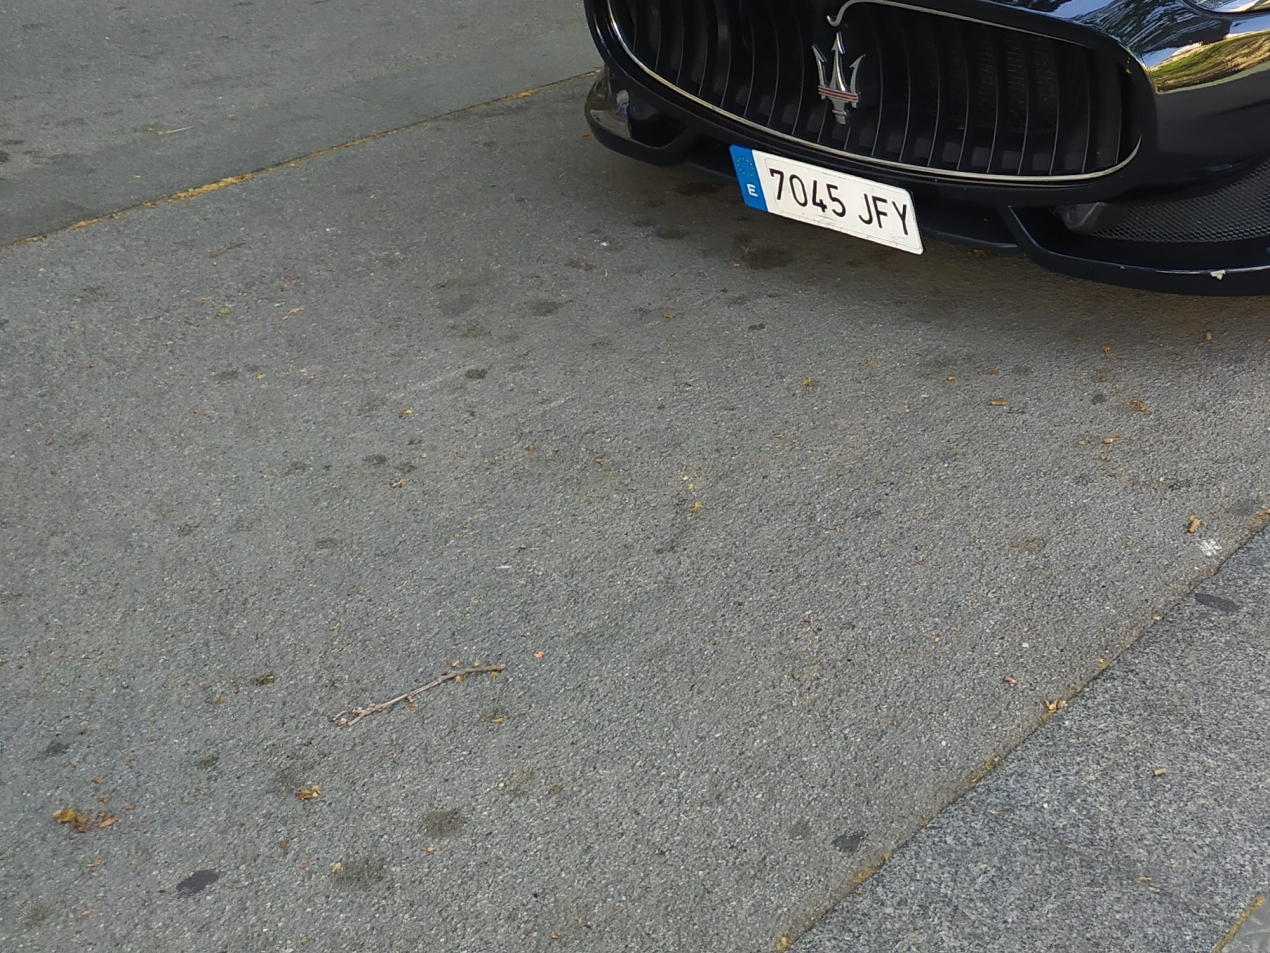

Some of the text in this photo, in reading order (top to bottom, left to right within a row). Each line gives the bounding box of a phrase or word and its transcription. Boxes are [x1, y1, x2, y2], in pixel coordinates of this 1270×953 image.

[746, 183, 758, 198] E
[769, 168, 908, 236] 7045 JFY
